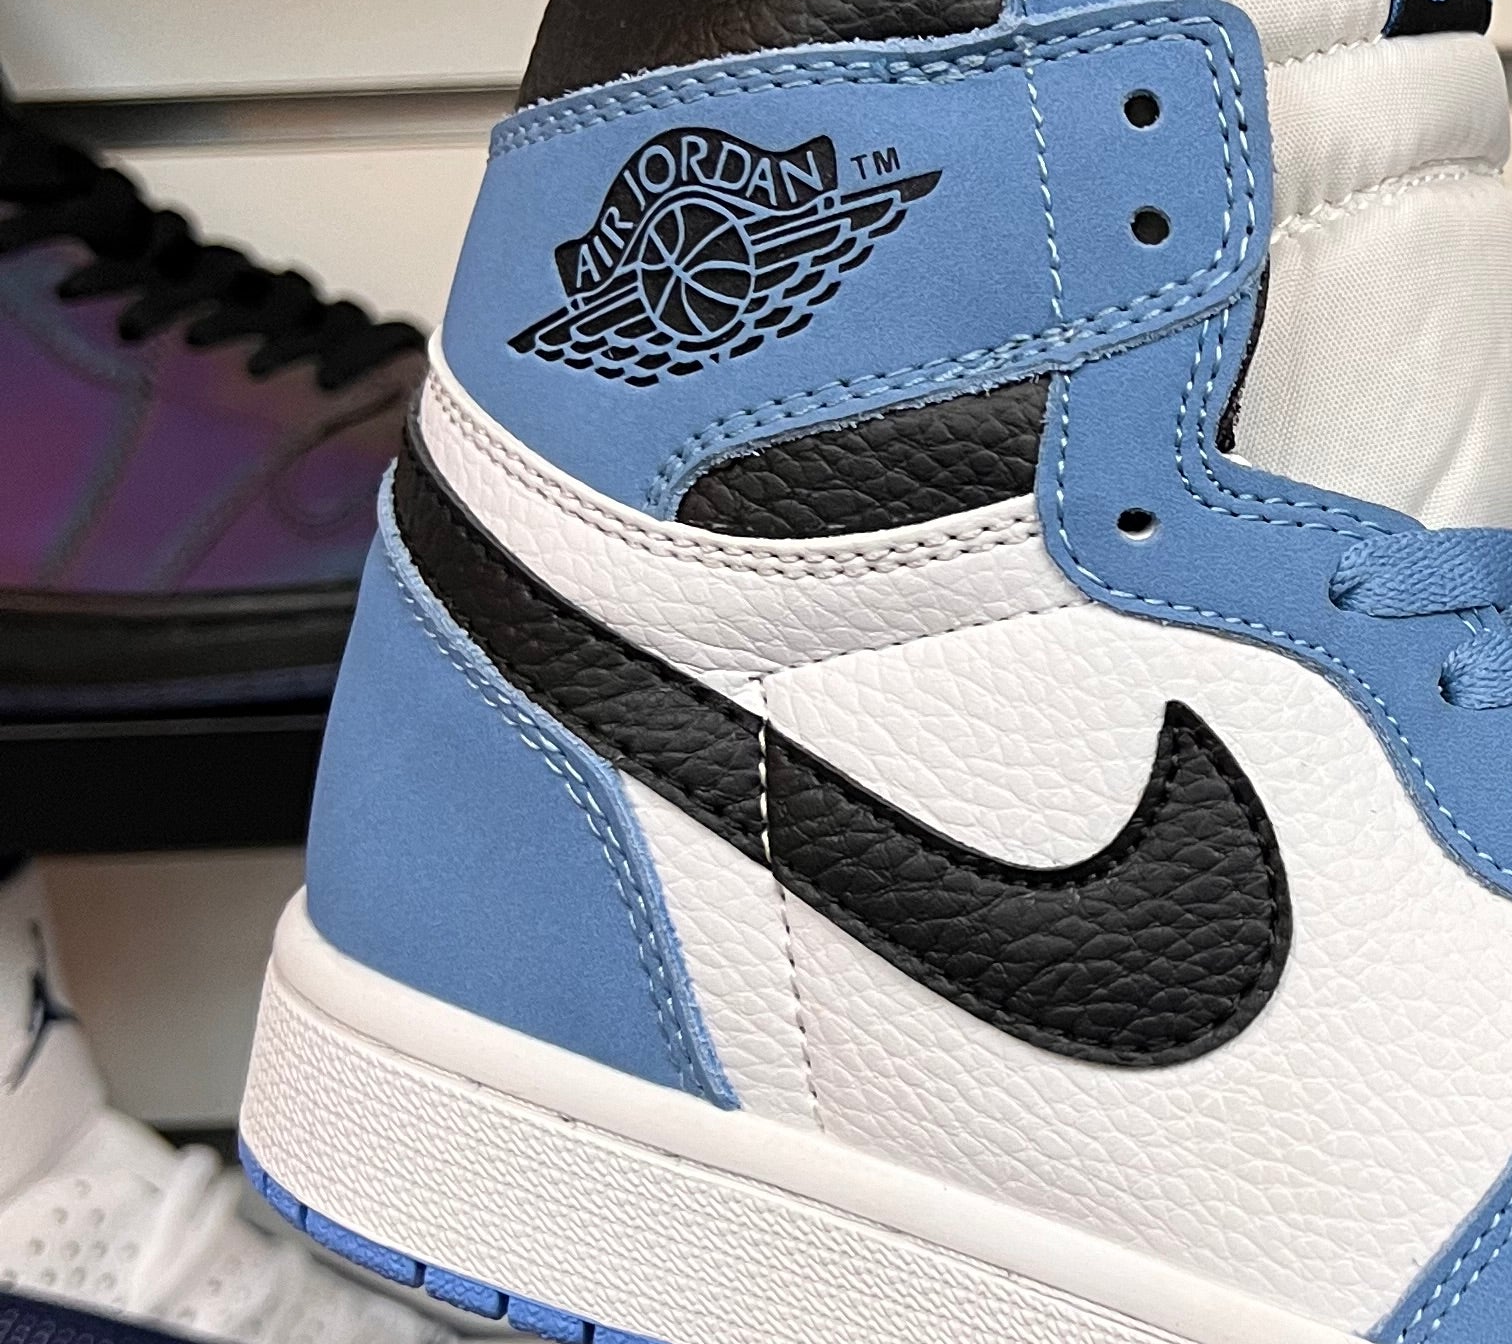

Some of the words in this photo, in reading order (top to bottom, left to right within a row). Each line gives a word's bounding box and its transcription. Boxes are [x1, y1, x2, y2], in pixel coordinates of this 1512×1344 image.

[575, 205, 634, 288] AIR
[623, 134, 826, 207] JORDAN
[850, 146, 901, 182] TM
